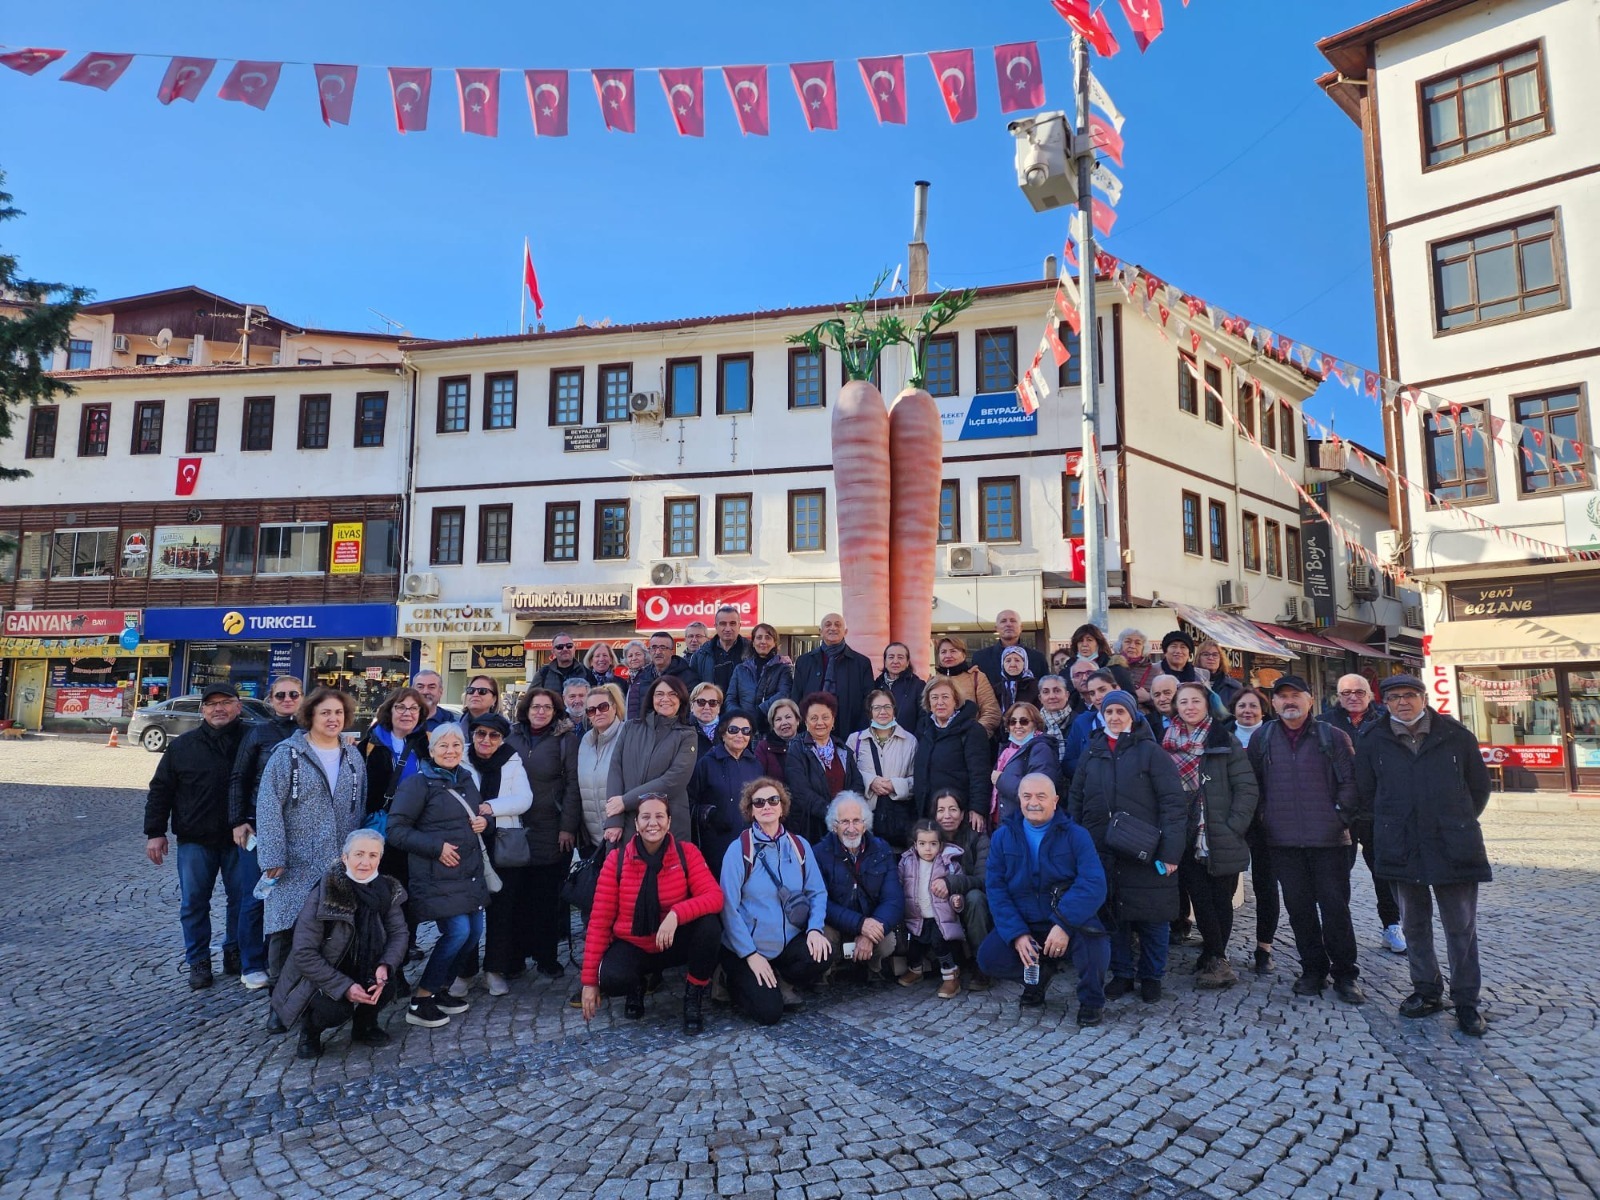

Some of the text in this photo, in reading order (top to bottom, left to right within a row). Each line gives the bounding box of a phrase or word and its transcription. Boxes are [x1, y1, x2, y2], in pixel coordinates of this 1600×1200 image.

[981, 406, 1029, 416] BEYPAZA
[969, 415, 1034, 426] İLÇE BAŞKANLIĞI
[1305, 536, 1331, 597] Filli Boya
[511, 590, 623, 608] TÜTÜNCÜOĞLU MARKET
[1464, 600, 1533, 615] ECZANE
[6, 614, 72, 632] GANYAN
[249, 616, 316, 629] TURKCELL
[405, 621, 502, 633] KUYUMCULUK
[1522, 646, 1600, 660] ECZA
[64, 704, 82, 712] 400
